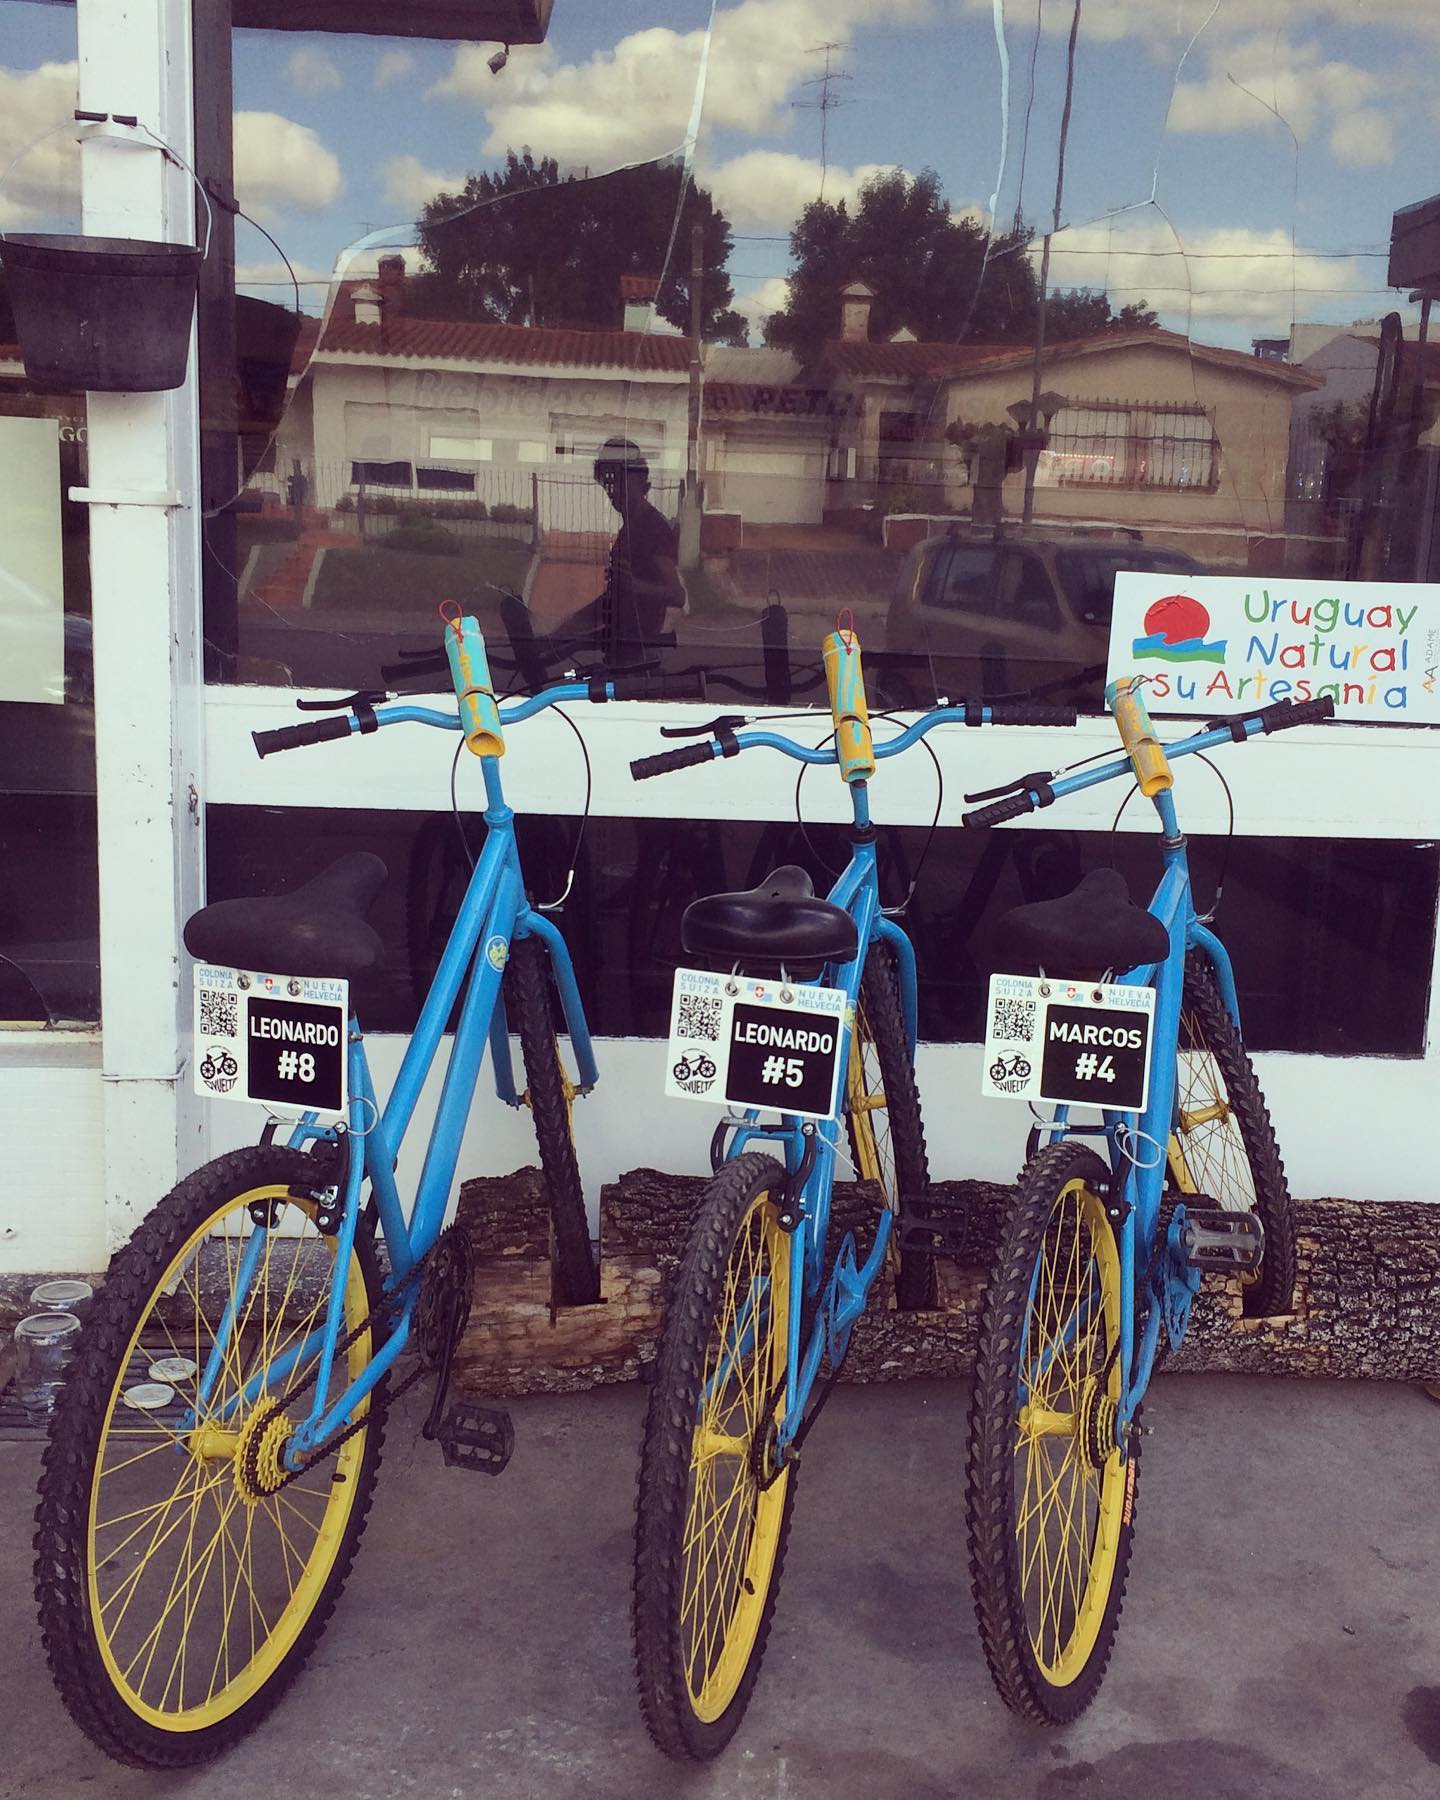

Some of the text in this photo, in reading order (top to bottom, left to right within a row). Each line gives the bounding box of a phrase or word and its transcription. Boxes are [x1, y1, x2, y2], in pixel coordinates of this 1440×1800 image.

[1244, 590, 1418, 635] Uruguay
[1246, 633, 1408, 672] Natural
[199, 968, 343, 992] COLONIA NUEVA
[200, 978, 343, 1001] SUIZA HELVECIA
[681, 973, 842, 1003] COLONIA NUEVA
[996, 978, 1151, 1000] COLONIA NUEVA
[680, 983, 841, 1012] SUIZA HELVECIA
[995, 987, 1150, 1008] SUIZA HELVECIA
[250, 1015, 339, 1047] LEONARDO
[734, 1021, 833, 1055] LEONARDO
[1050, 1022, 1142, 1049] MARCOS
[278, 1050, 316, 1083] #8
[761, 1055, 804, 1088] #5
[1075, 1052, 1116, 1083] #4
